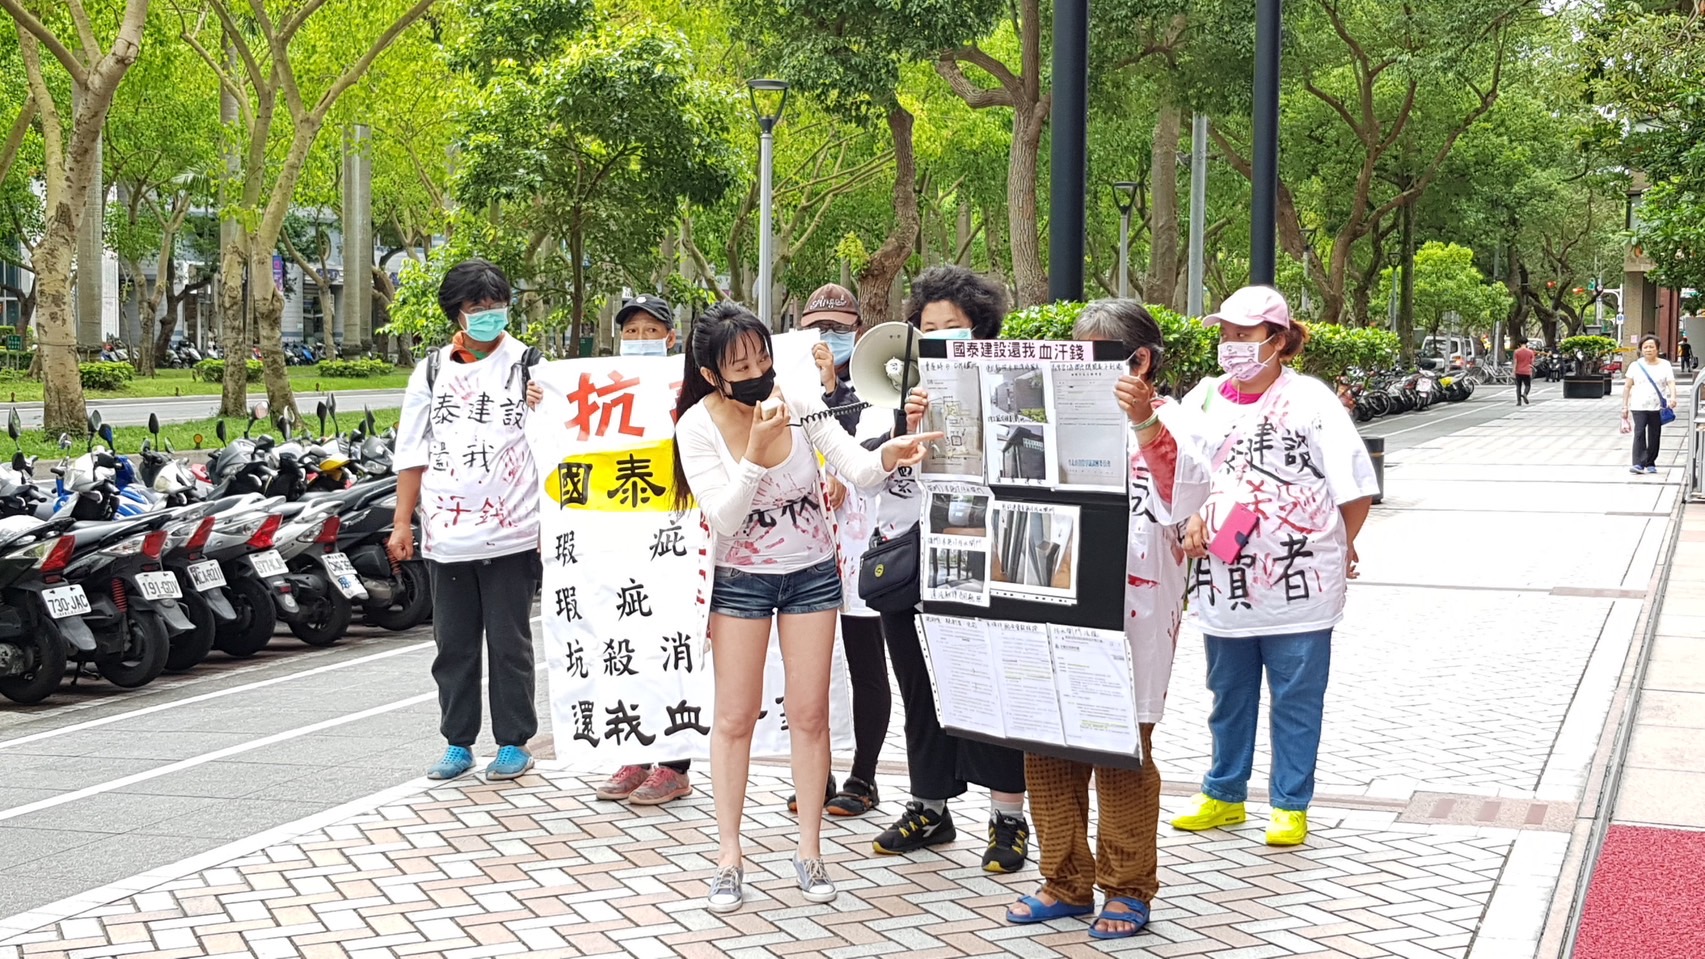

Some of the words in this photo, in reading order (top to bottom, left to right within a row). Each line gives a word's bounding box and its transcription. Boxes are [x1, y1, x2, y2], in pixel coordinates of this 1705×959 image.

[953, 341, 1085, 361] 國泰建設還我血汗錢
[432, 391, 528, 430] 泰建設
[557, 453, 667, 511] 國泰
[47, 594, 89, 614] 730-JAC
[555, 577, 653, 623] 瑕疵
[566, 631, 693, 678] 坑殺消
